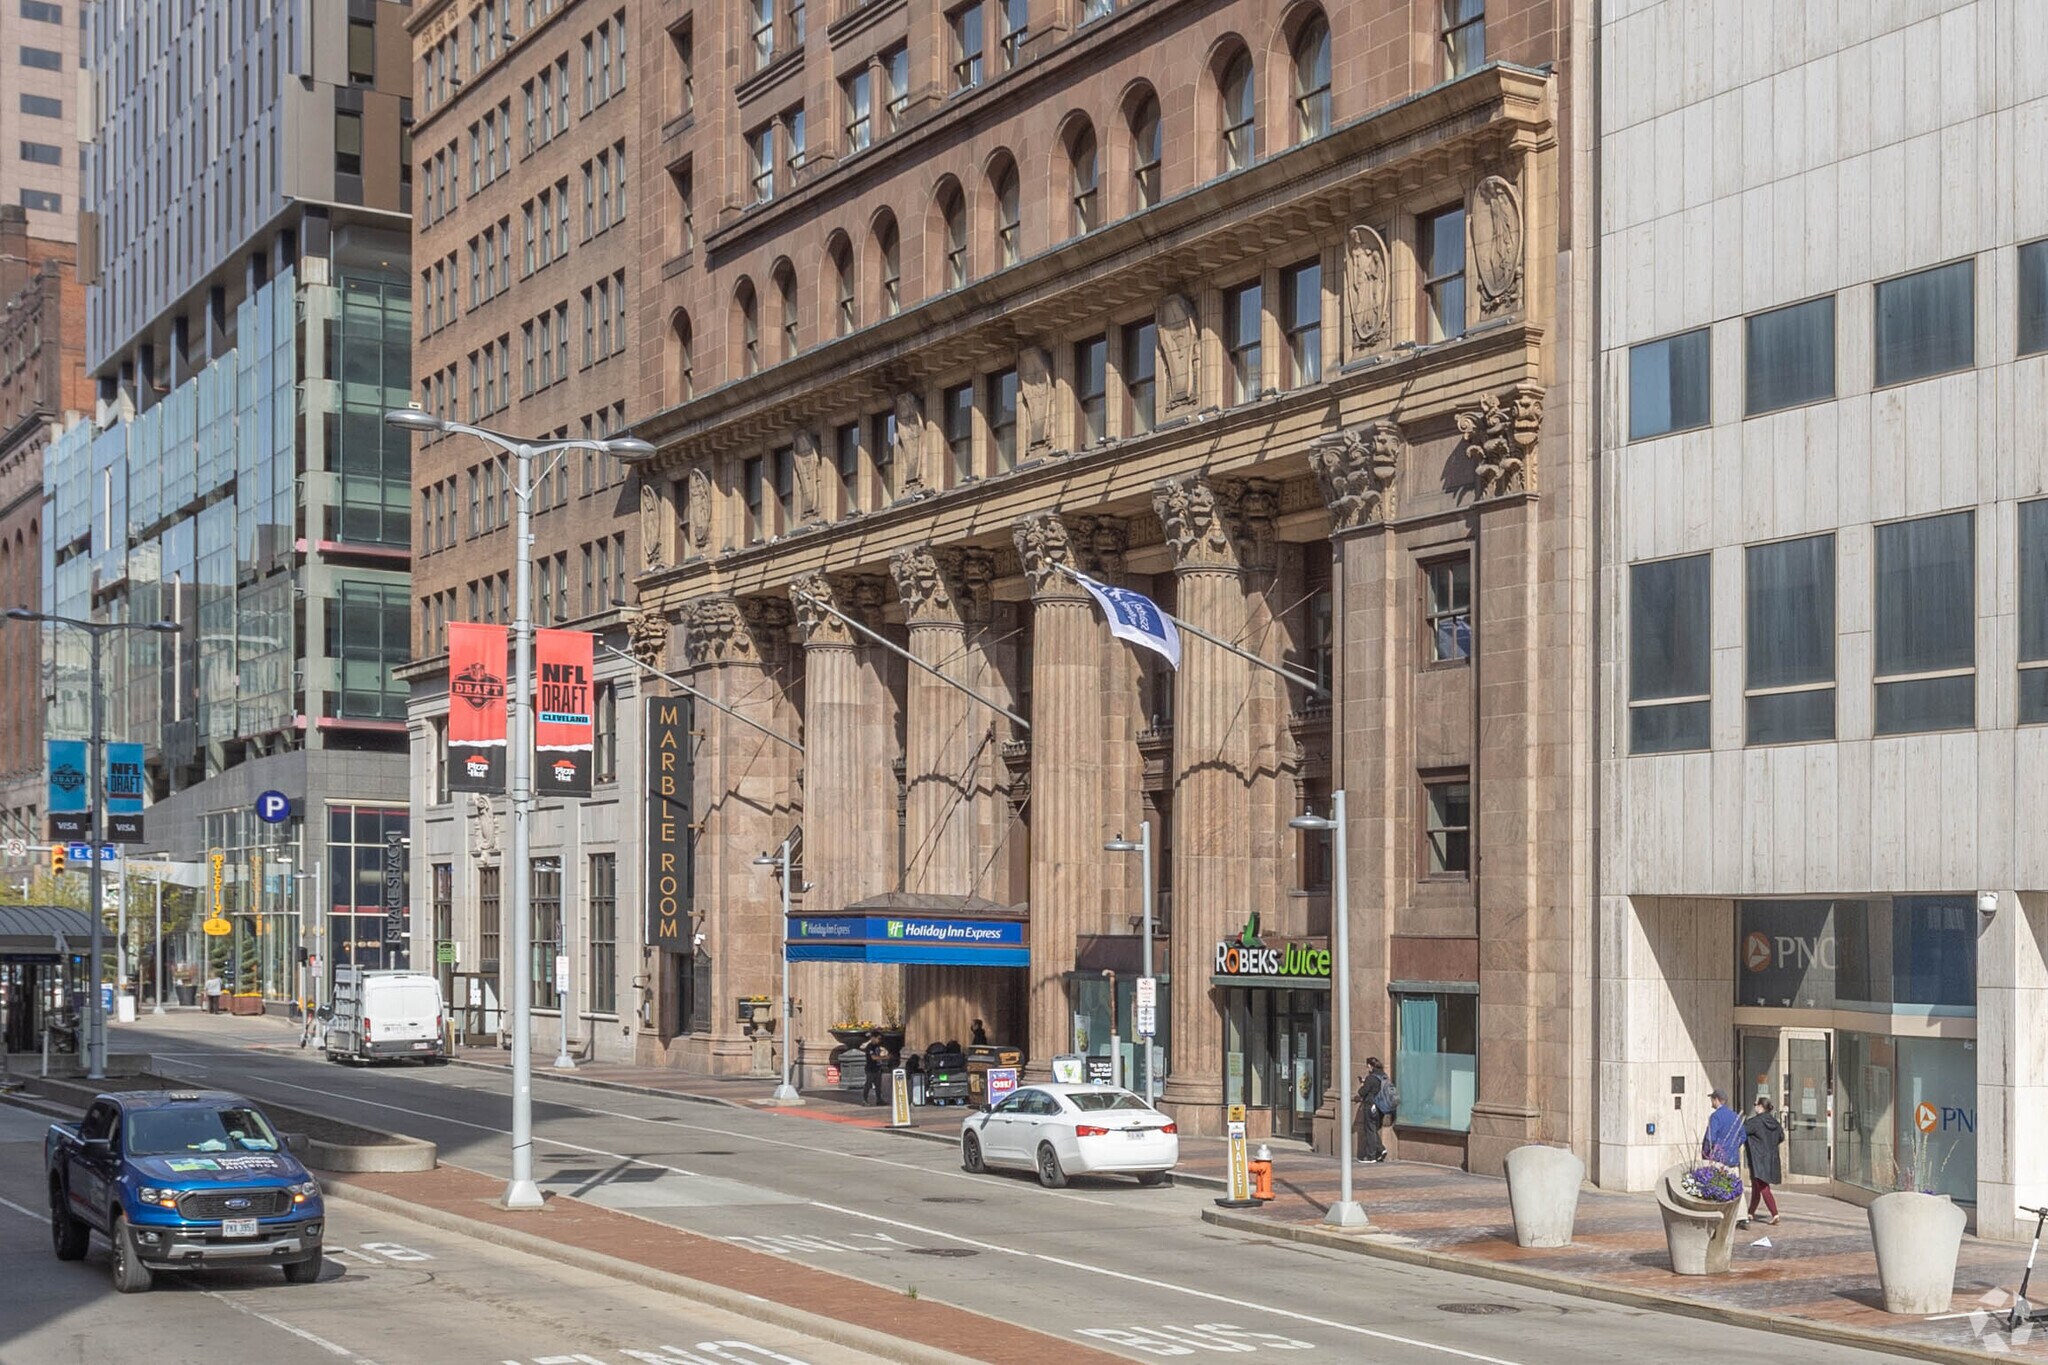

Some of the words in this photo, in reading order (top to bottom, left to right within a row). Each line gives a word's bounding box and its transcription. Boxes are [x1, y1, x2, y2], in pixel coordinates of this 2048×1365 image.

[542, 663, 587, 684] NFL
[455, 683, 501, 695] DRAFT
[542, 684, 587, 714] DRAFT
[542, 713, 588, 723] CLEVELAND
[111, 763, 140, 775] NFL
[659, 705, 678, 842] MARBLE
[111, 775, 141, 793] DRAFT
[266, 796, 285, 817] P
[57, 822, 79, 830] VISA
[115, 824, 136, 832] VISA
[387, 834, 401, 888] SHACK
[659, 853, 678, 937] ROOM
[387, 889, 401, 939] SHAKE
[905, 923, 946, 940] Holiday
[947, 925, 964, 937] Inn
[965, 926, 1001, 940] Express
[1216, 942, 1278, 975] ROBEKS
[1775, 936, 1837, 970] PNC
[1941, 1107, 1977, 1133] PN
[1234, 1140, 1243, 1194] VALET
[1073, 1323, 1316, 1356] BUS
